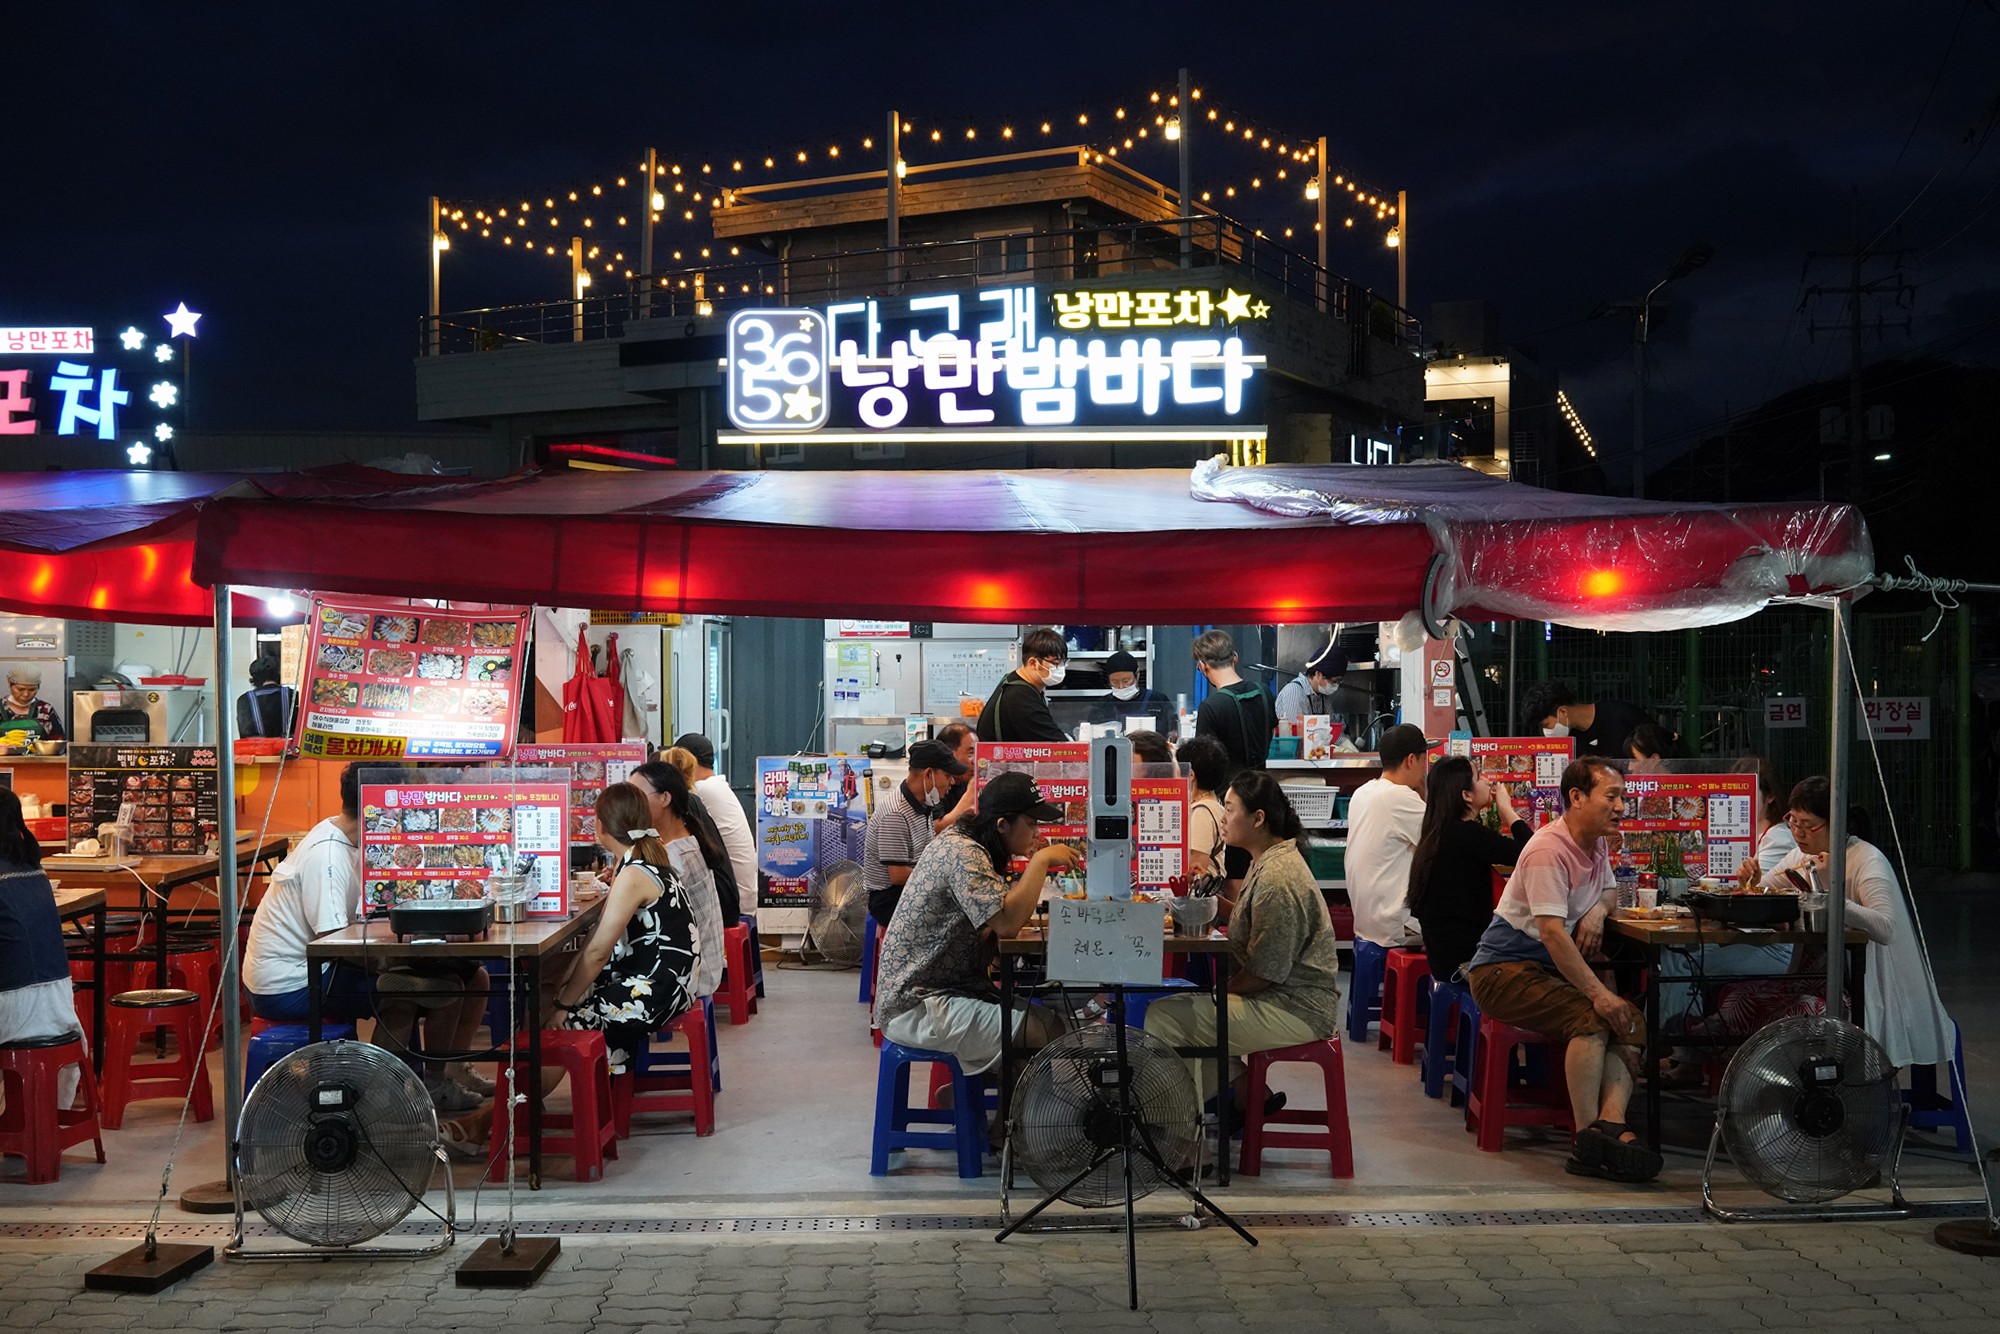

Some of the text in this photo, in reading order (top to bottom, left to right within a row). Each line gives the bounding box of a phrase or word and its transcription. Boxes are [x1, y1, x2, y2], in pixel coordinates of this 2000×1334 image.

[1053, 288, 1214, 329] 낭만포차
[7, 330, 93, 351] 낭만포차
[839, 337, 1254, 428] 낭만밤바다
[1769, 703, 1802, 721] 금연
[1864, 701, 1922, 722] 화장실
[1004, 747, 1052, 759] 낭만밤바다
[399, 790, 461, 805] 낭만밤바다
[1040, 785, 1087, 799] 만밤바다
